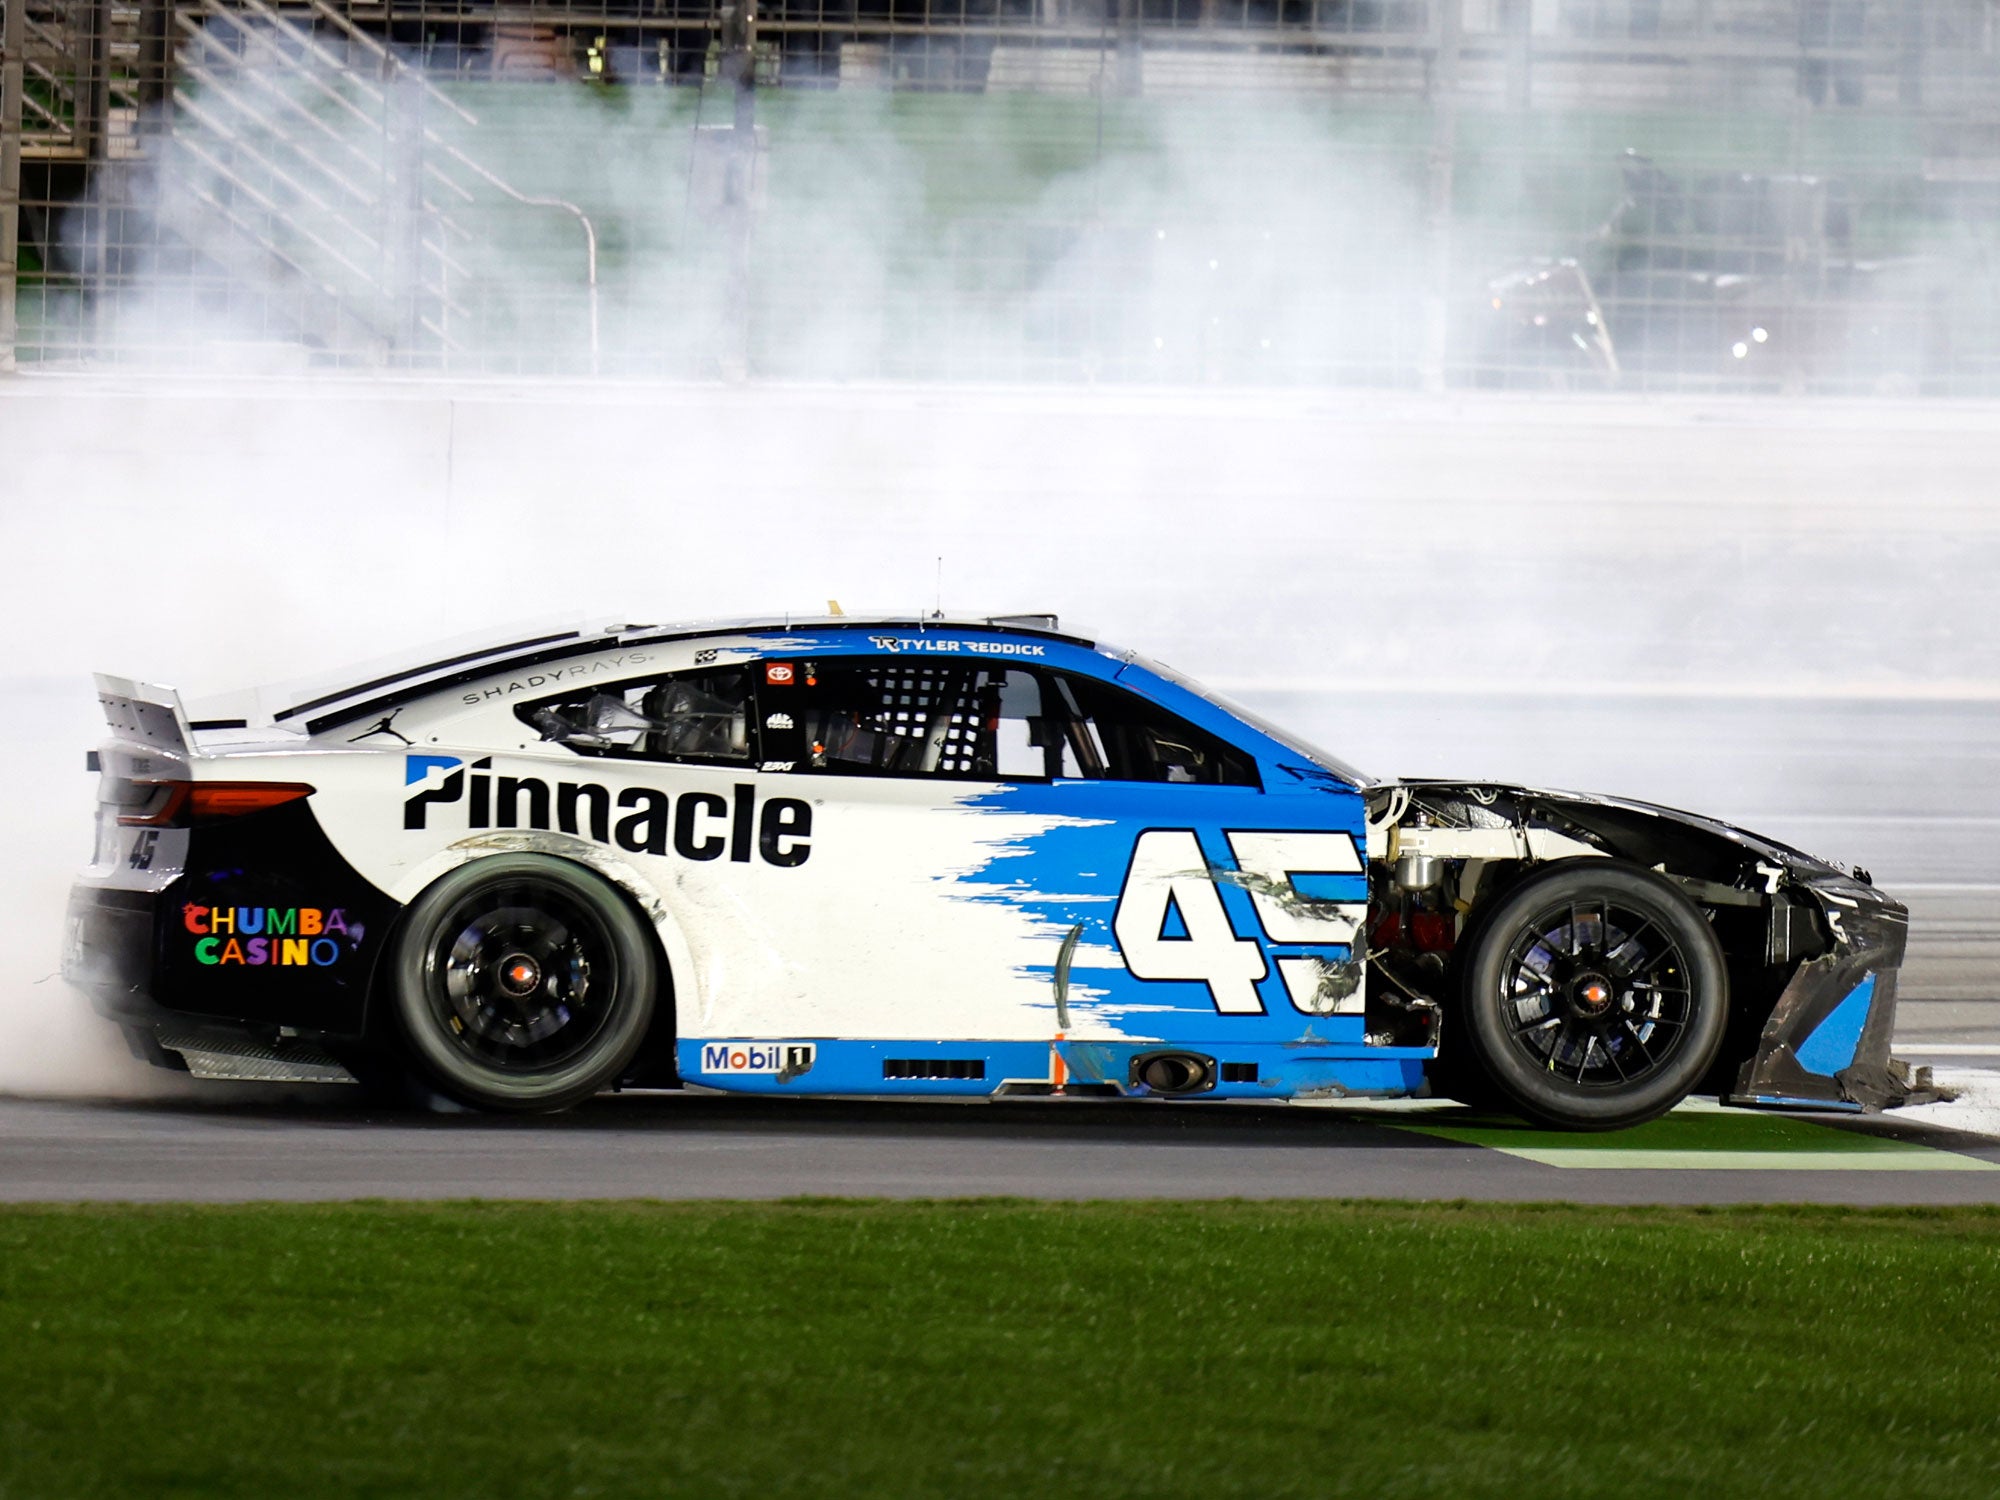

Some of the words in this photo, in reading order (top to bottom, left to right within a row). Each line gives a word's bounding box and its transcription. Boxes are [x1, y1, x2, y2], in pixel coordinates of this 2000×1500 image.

[900, 639, 960, 651] TYLER
[962, 641, 1046, 656] REDDICK
[404, 754, 812, 868] Pinnacle
[183, 903, 348, 935] CHUMBA
[1112, 827, 1368, 1016] 45
[195, 937, 339, 966] CASINO
[706, 1047, 780, 1069] Mobil
